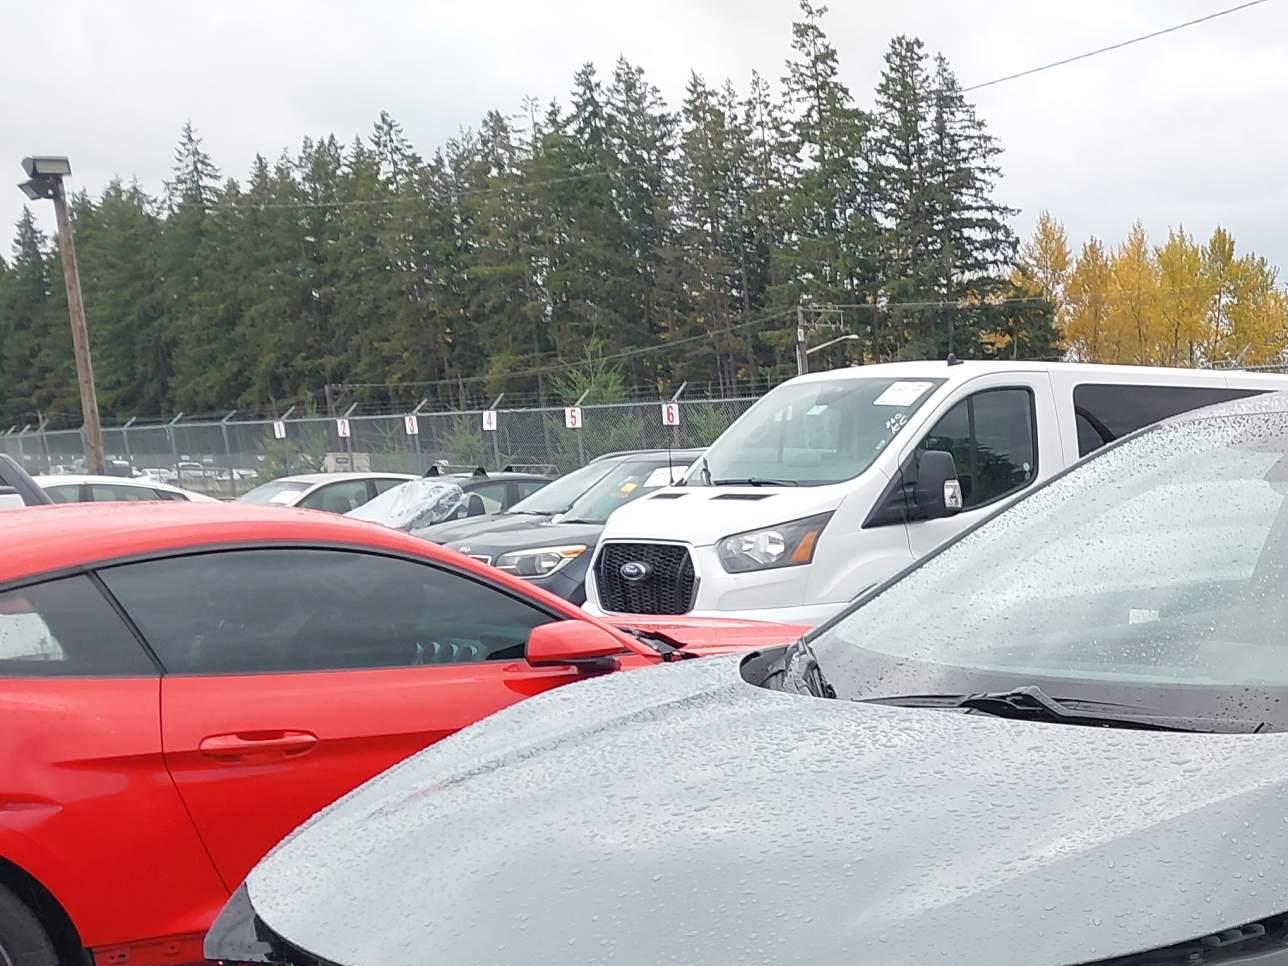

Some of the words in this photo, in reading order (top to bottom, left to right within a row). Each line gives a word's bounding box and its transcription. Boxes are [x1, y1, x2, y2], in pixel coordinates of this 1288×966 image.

[486, 413, 493, 429] 4
[570, 409, 576, 426] 5
[667, 405, 674, 423] 6
[277, 423, 282, 439] 1
[341, 420, 347, 436] 2
[409, 415, 416, 433] 3
